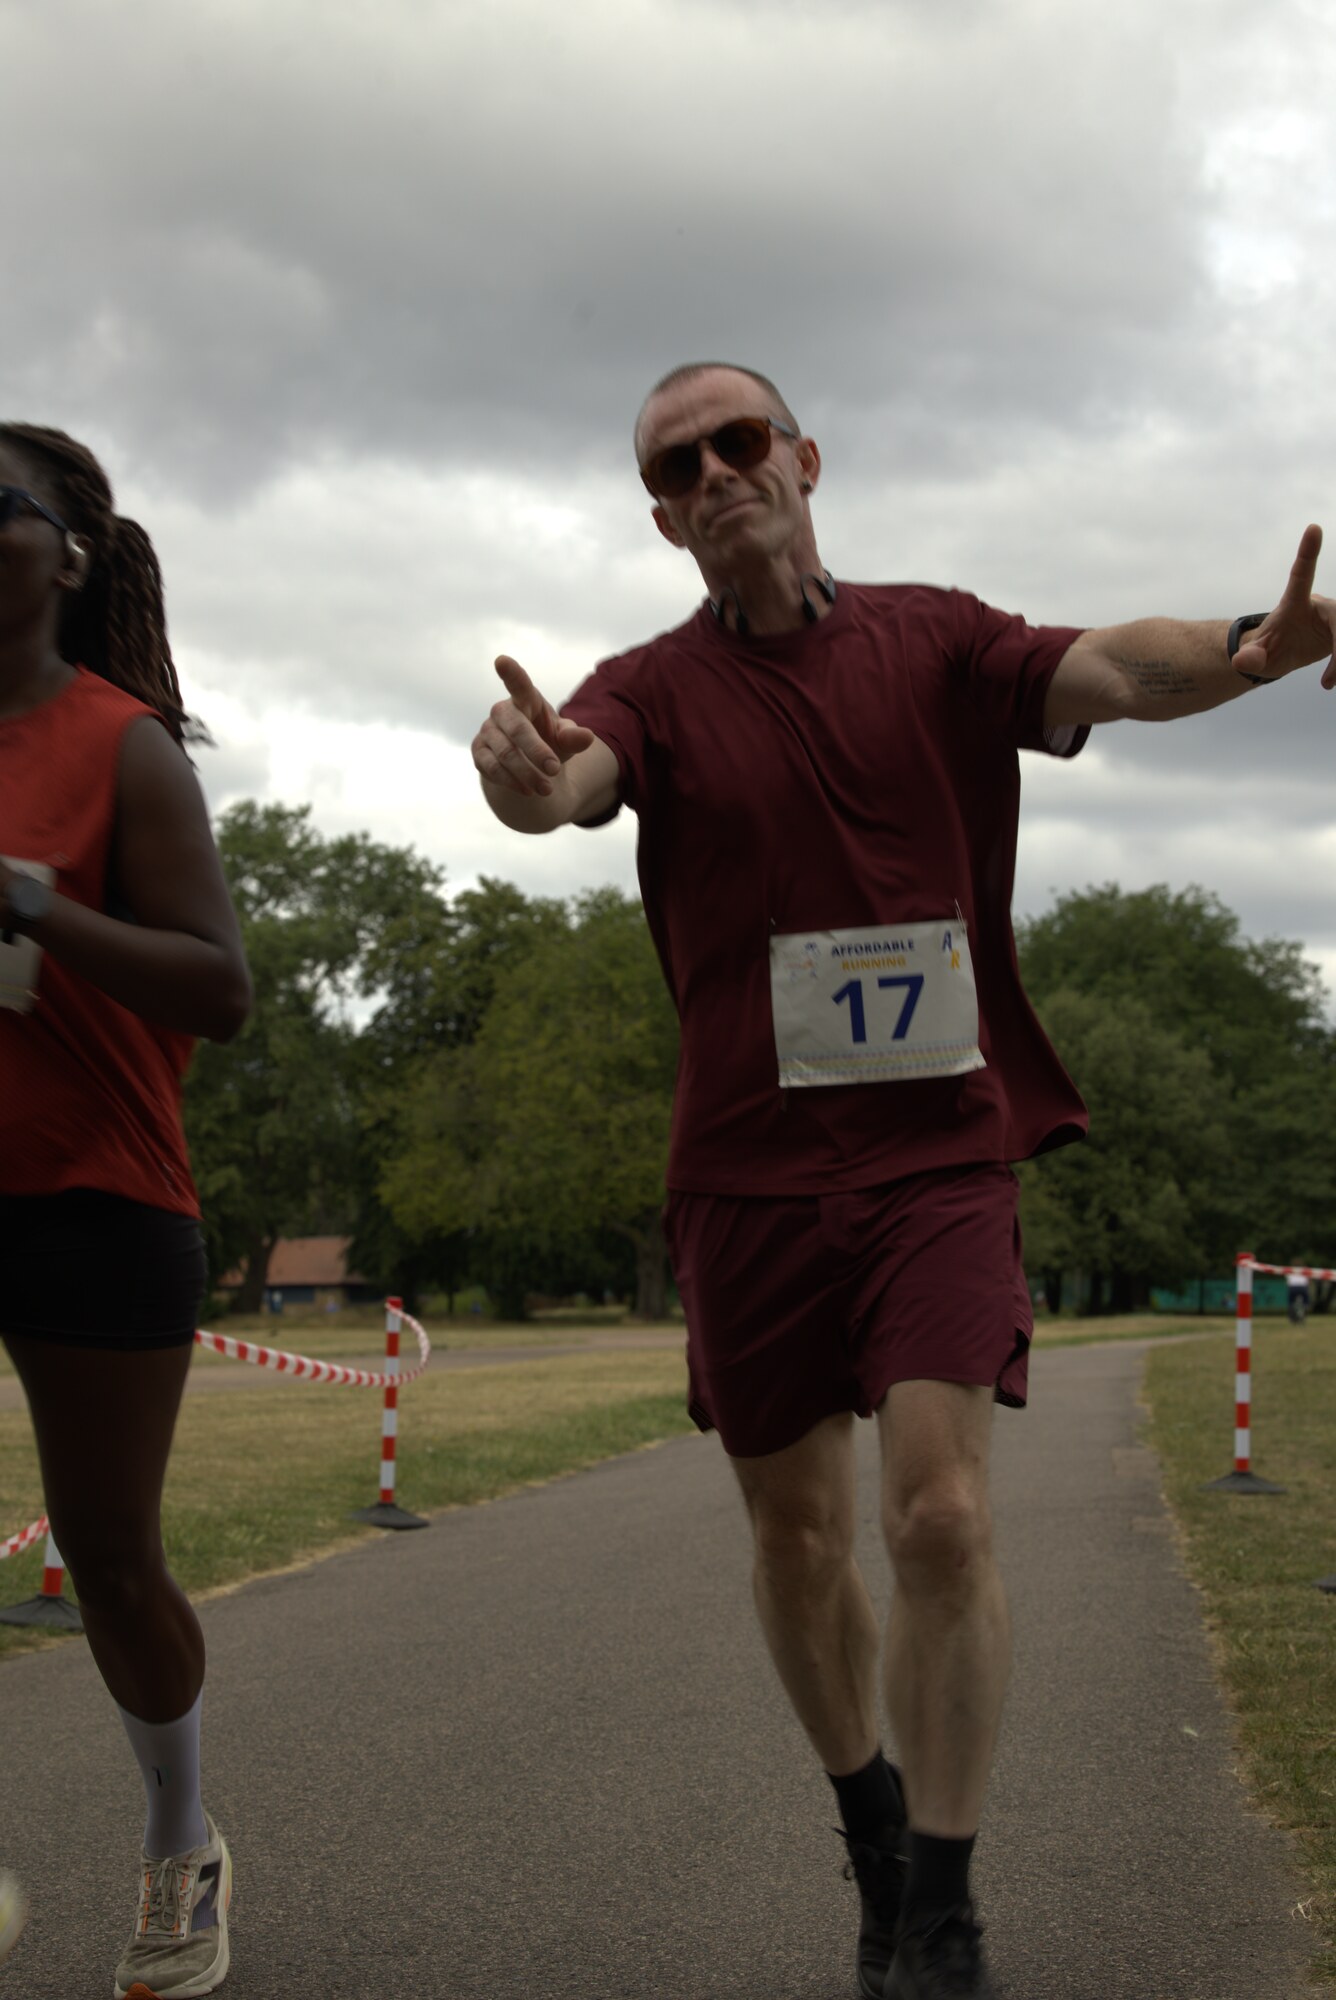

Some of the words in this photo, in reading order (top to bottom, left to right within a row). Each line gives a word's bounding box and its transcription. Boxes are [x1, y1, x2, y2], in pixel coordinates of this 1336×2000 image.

[831, 938, 915, 957] AFFORDABLE
[841, 955, 906, 971] RUNNING
[831, 972, 925, 1044] 17
